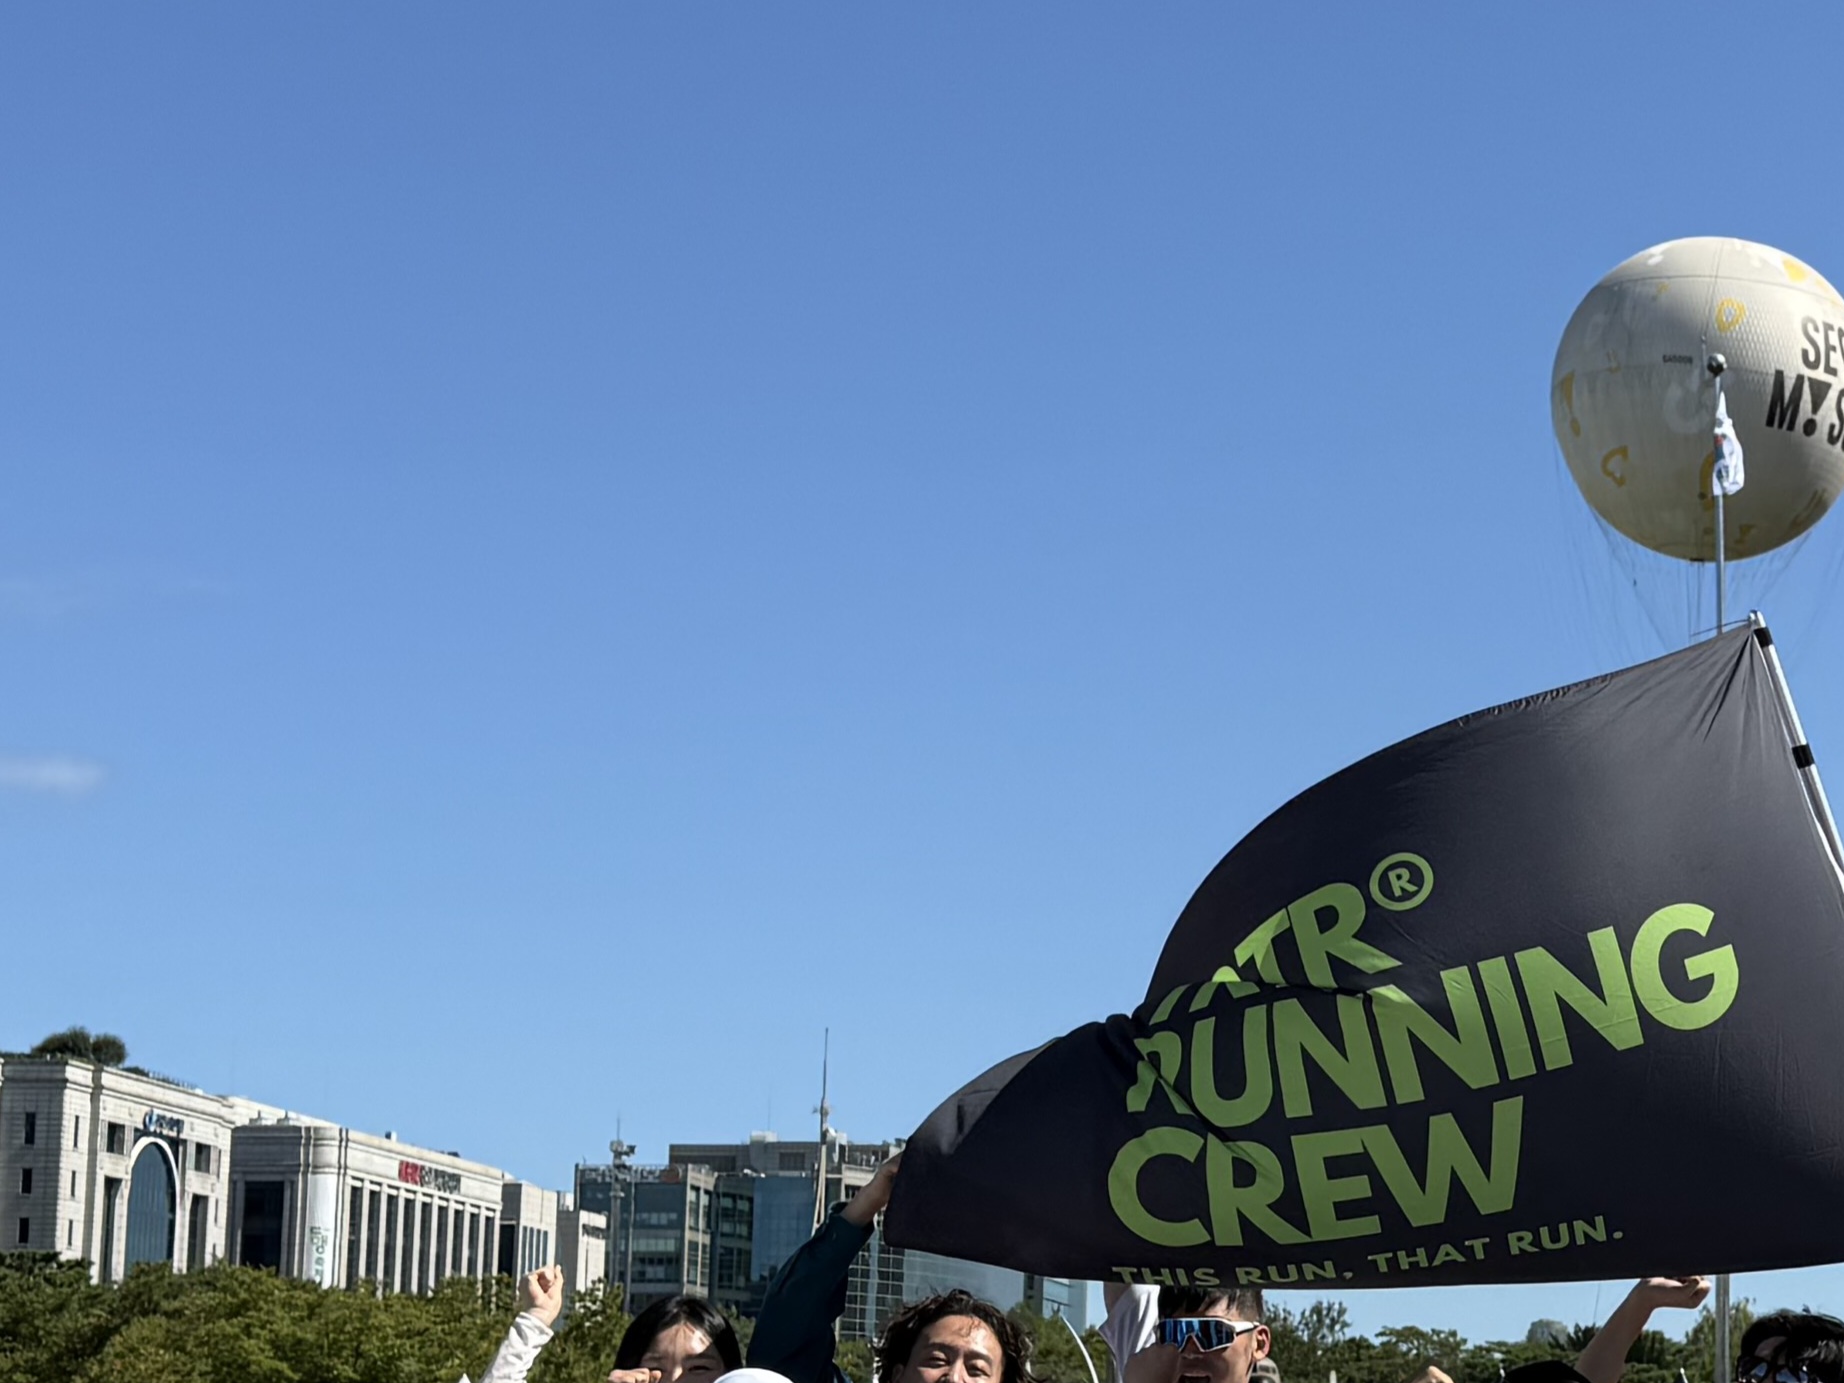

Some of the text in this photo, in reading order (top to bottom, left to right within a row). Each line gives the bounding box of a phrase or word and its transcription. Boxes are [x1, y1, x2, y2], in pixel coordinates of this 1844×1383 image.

[1126, 903, 1740, 1127] RUNNING
[1108, 1096, 1524, 1246] CREW
[1112, 1215, 1624, 1287] THIS RUN, THAT RUN.
